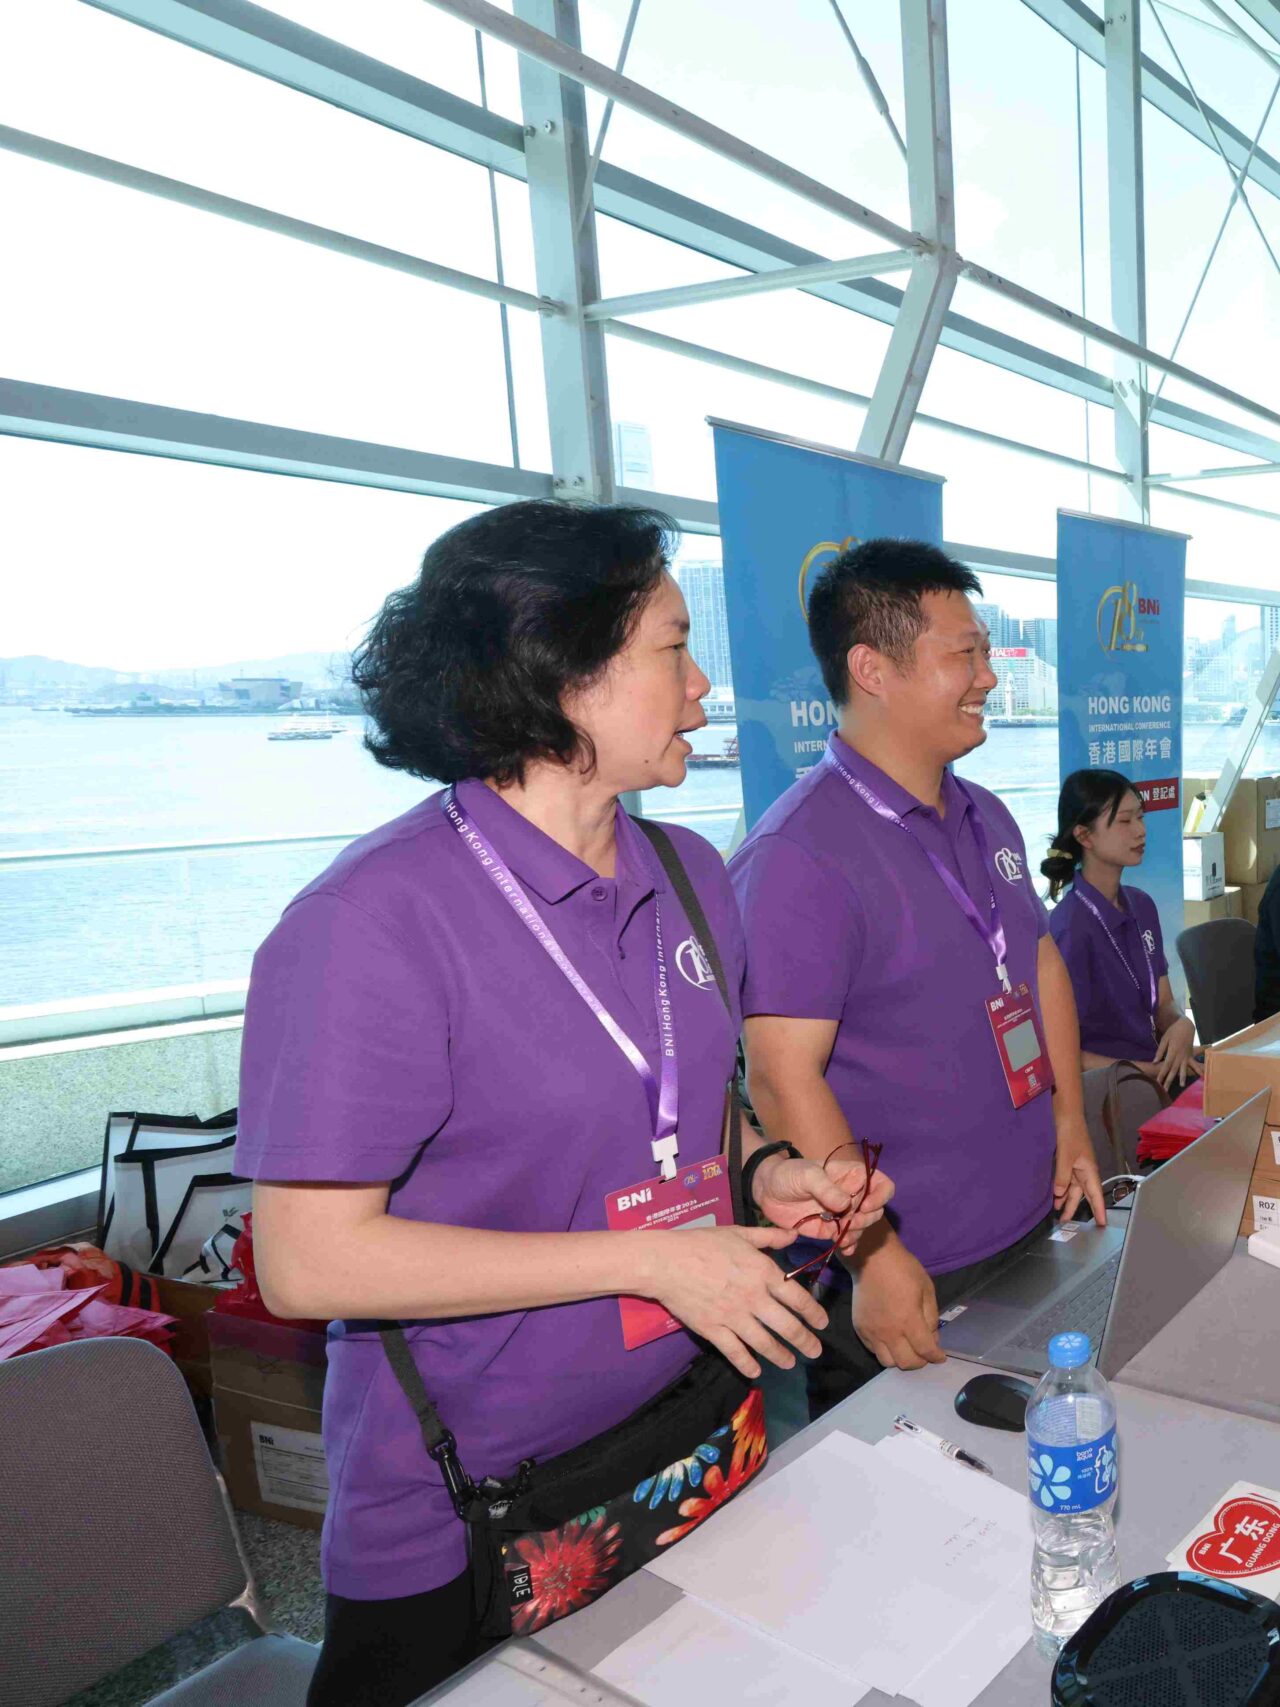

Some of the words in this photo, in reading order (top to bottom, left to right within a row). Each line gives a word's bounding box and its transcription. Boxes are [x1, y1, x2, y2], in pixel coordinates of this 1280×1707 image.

[790, 700, 841, 727] HON
[1088, 696, 1129, 714] HONG
[1133, 695, 1171, 713] KONG
[1088, 723, 1134, 733] INTERNATIONAL
[1135, 721, 1171, 730] CONFERENCE
[794, 741, 829, 753] INTERN
[1088, 737, 1171, 766] 香港國際年會
[838, 764, 855, 785] Hong
[854, 780, 876, 803] Kong
[446, 802, 469, 833] Hong
[465, 831, 493, 867] Kong
[490, 866, 557, 951] International
[658, 966, 668, 997] Kong
[661, 1000, 672, 1031] Hong
[990, 998, 1005, 1012] BNI
[664, 1034, 675, 1056] BNI
[617, 1187, 653, 1212] BNI
[1258, 1201, 1275, 1210] ROZ
[259, 1434, 274, 1446] BNI
[1198, 1543, 1212, 1556] BNI
[1218, 1515, 1269, 1564] 广东
[1245, 1542, 1267, 1568] GUANG
[1262, 1523, 1280, 1543] DONG
